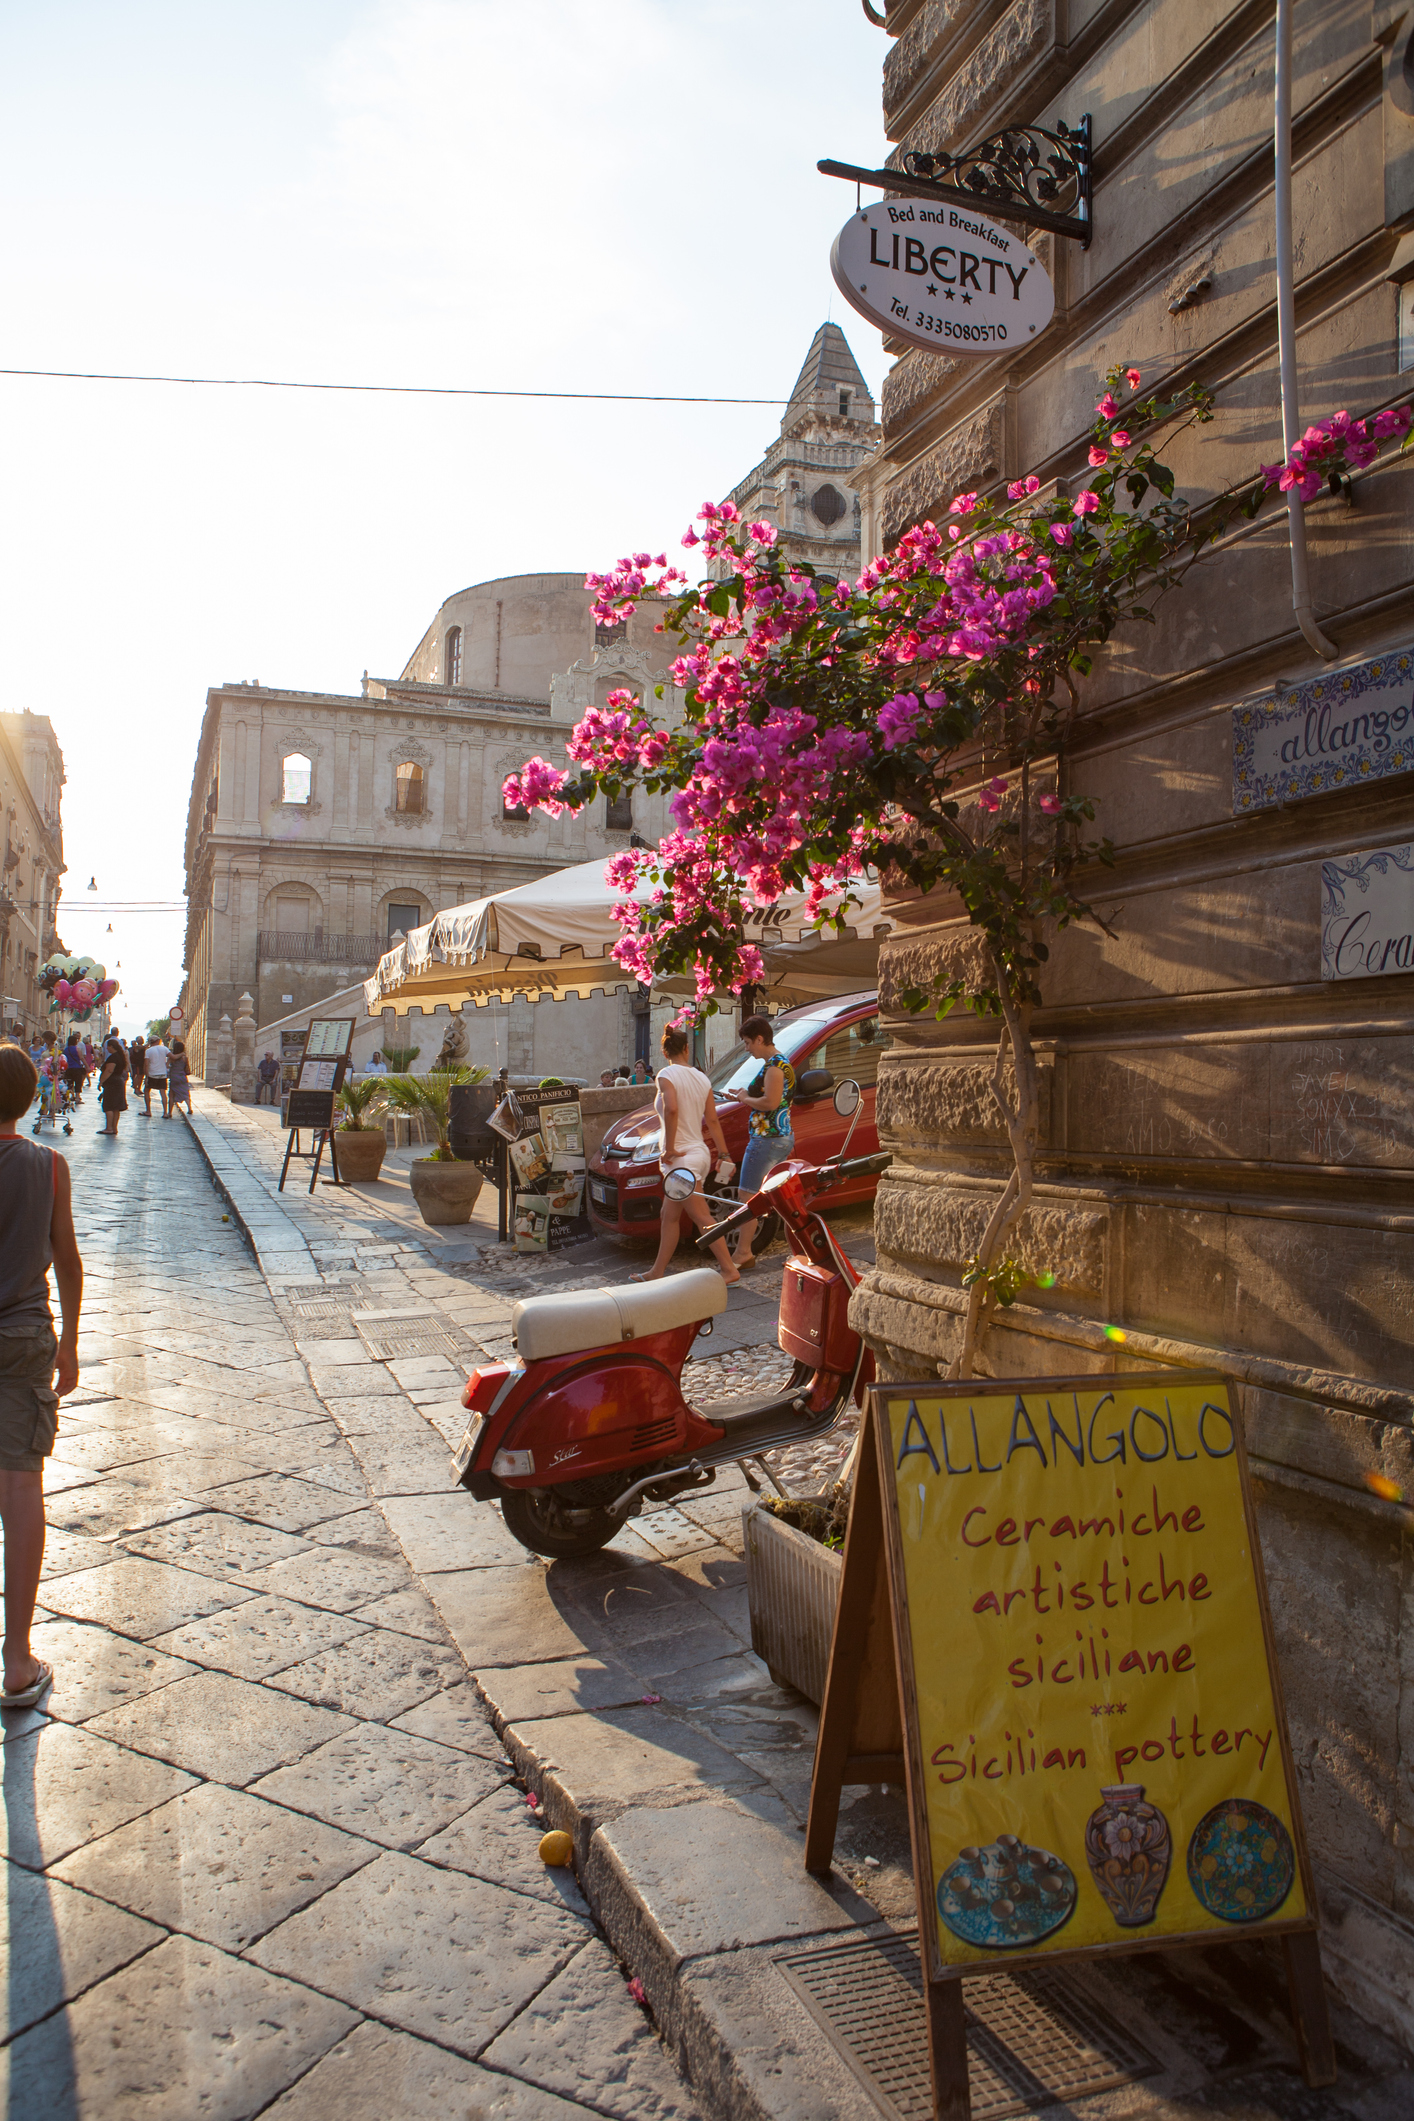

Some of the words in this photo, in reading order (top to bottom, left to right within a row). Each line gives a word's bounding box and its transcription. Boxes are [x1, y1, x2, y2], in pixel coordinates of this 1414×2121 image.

[887, 205, 915, 223] Bed
[919, 209, 944, 224] and
[949, 211, 1010, 252] Breakfast
[870, 228, 1029, 301] LIBERTY
[890, 297, 910, 322] Tel.
[915, 312, 1007, 341] 3335080570
[1281, 690, 1414, 763] allango
[1329, 911, 1414, 976] Cera
[517, 1093, 538, 1102] NTICO
[897, 1392, 1236, 1475] ALLANGOLO
[961, 1484, 1205, 1548] Ceramiche
[973, 1552, 1212, 1615] artistiche
[1008, 1628, 1196, 1688] siciliane
[931, 1730, 1087, 1784] Sicilian
[1115, 1715, 1272, 1784] pottery
